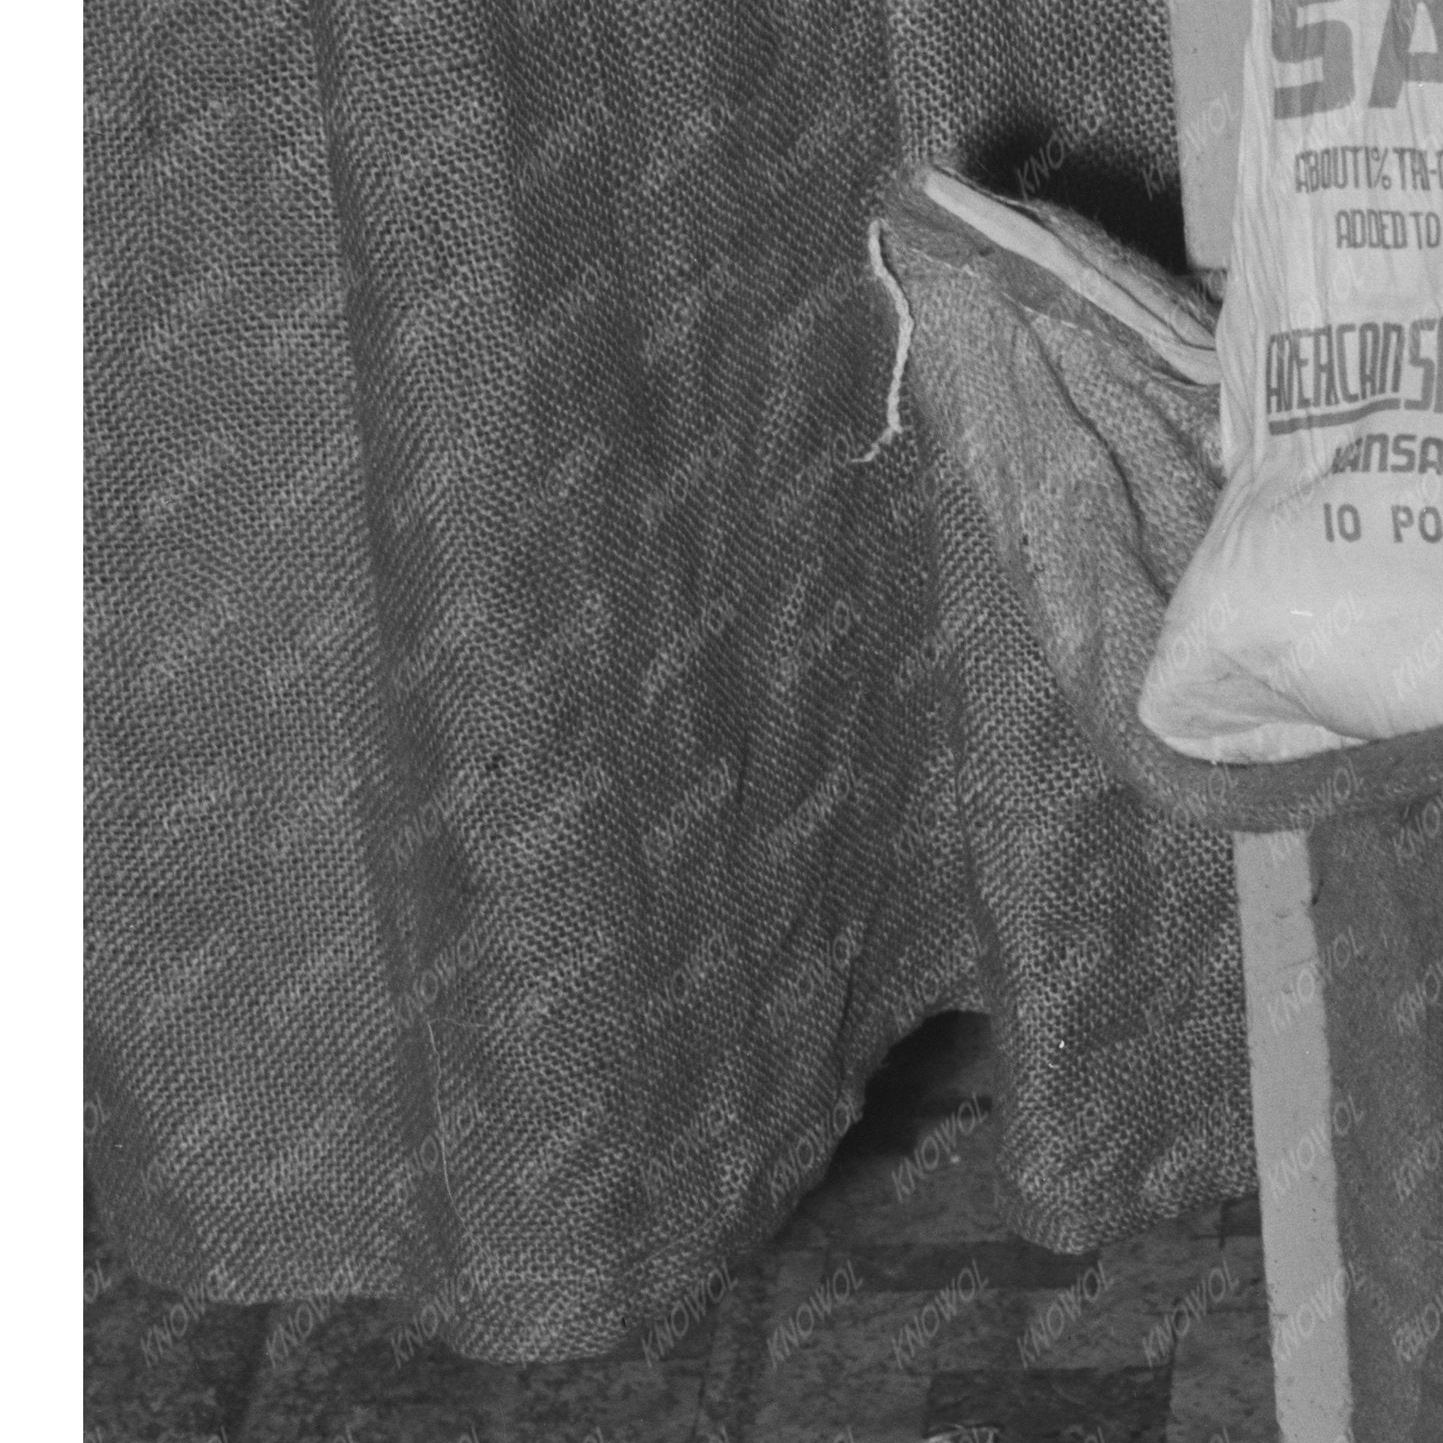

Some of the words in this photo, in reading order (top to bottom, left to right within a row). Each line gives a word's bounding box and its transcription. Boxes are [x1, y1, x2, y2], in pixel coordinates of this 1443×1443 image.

[1335, 208, 1408, 250] ADDED
[1410, 210, 1442, 251] TO
[1322, 502, 1362, 543] 10
